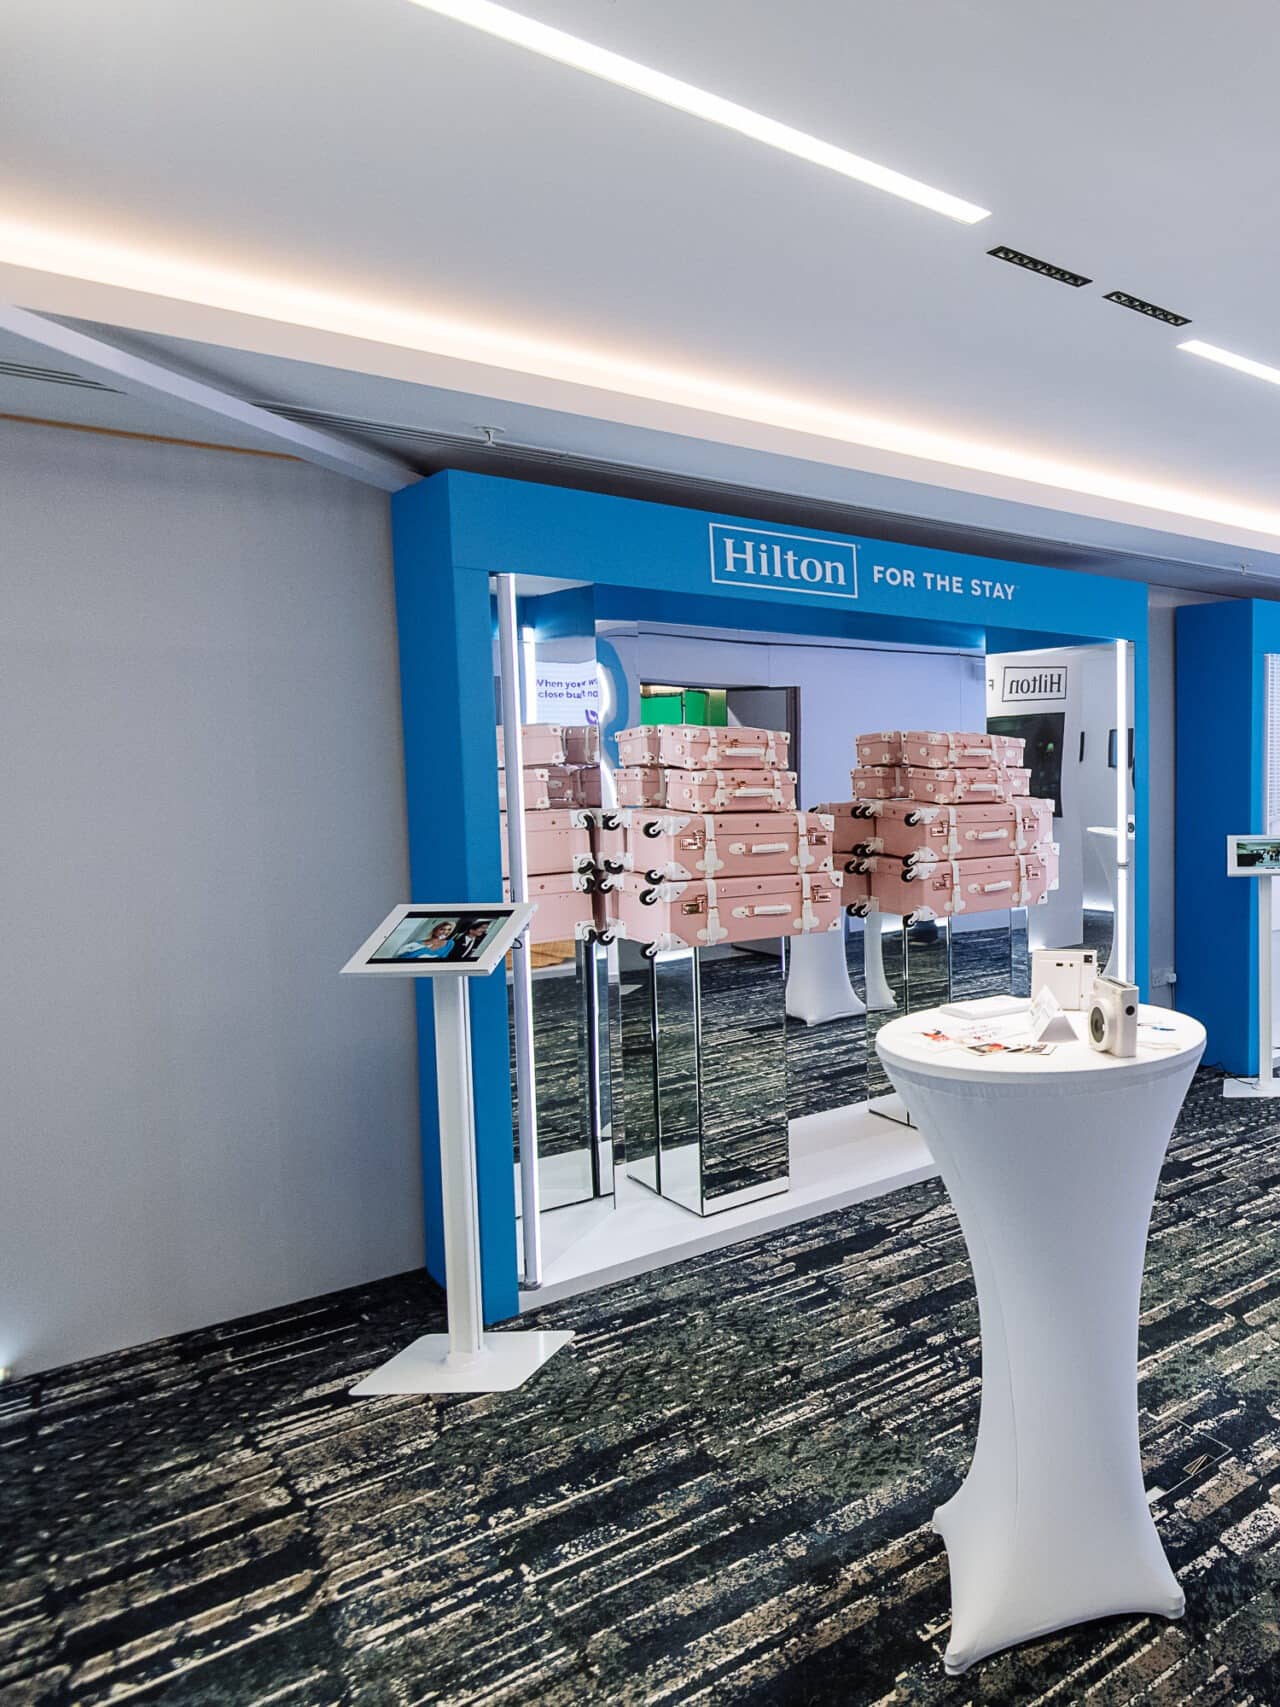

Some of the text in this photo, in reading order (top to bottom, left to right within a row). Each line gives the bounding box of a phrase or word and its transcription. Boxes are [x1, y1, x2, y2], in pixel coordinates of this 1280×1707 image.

[723, 538, 1015, 600] Hilton FOR THE STAY
[538, 690, 564, 698] close
